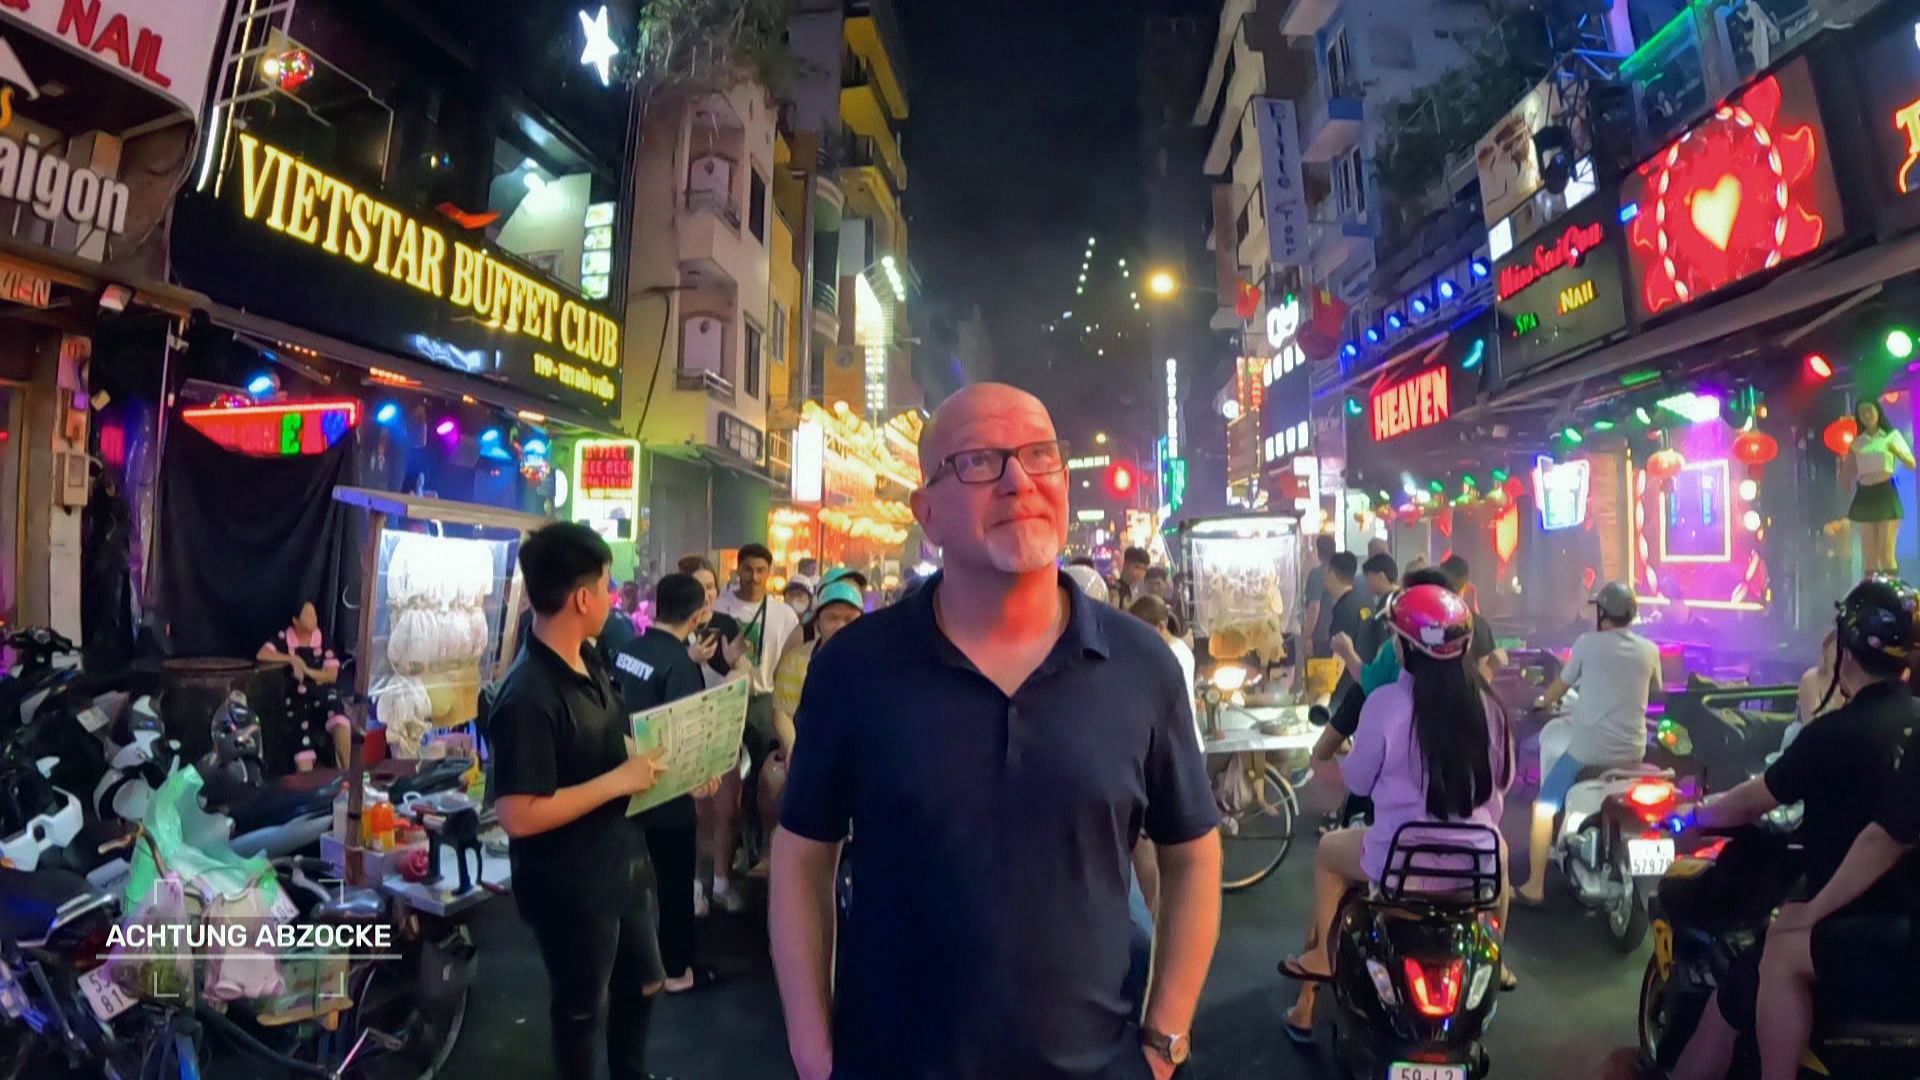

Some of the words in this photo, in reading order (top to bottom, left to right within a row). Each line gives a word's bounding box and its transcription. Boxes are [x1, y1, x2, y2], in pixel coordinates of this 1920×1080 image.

[57, 0, 172, 88] NAIL
[239, 132, 444, 297] VIETSTAR
[449, 241, 561, 343] BUFFET
[560, 300, 618, 368] CLUB
[1373, 364, 1449, 442] HEAVEN
